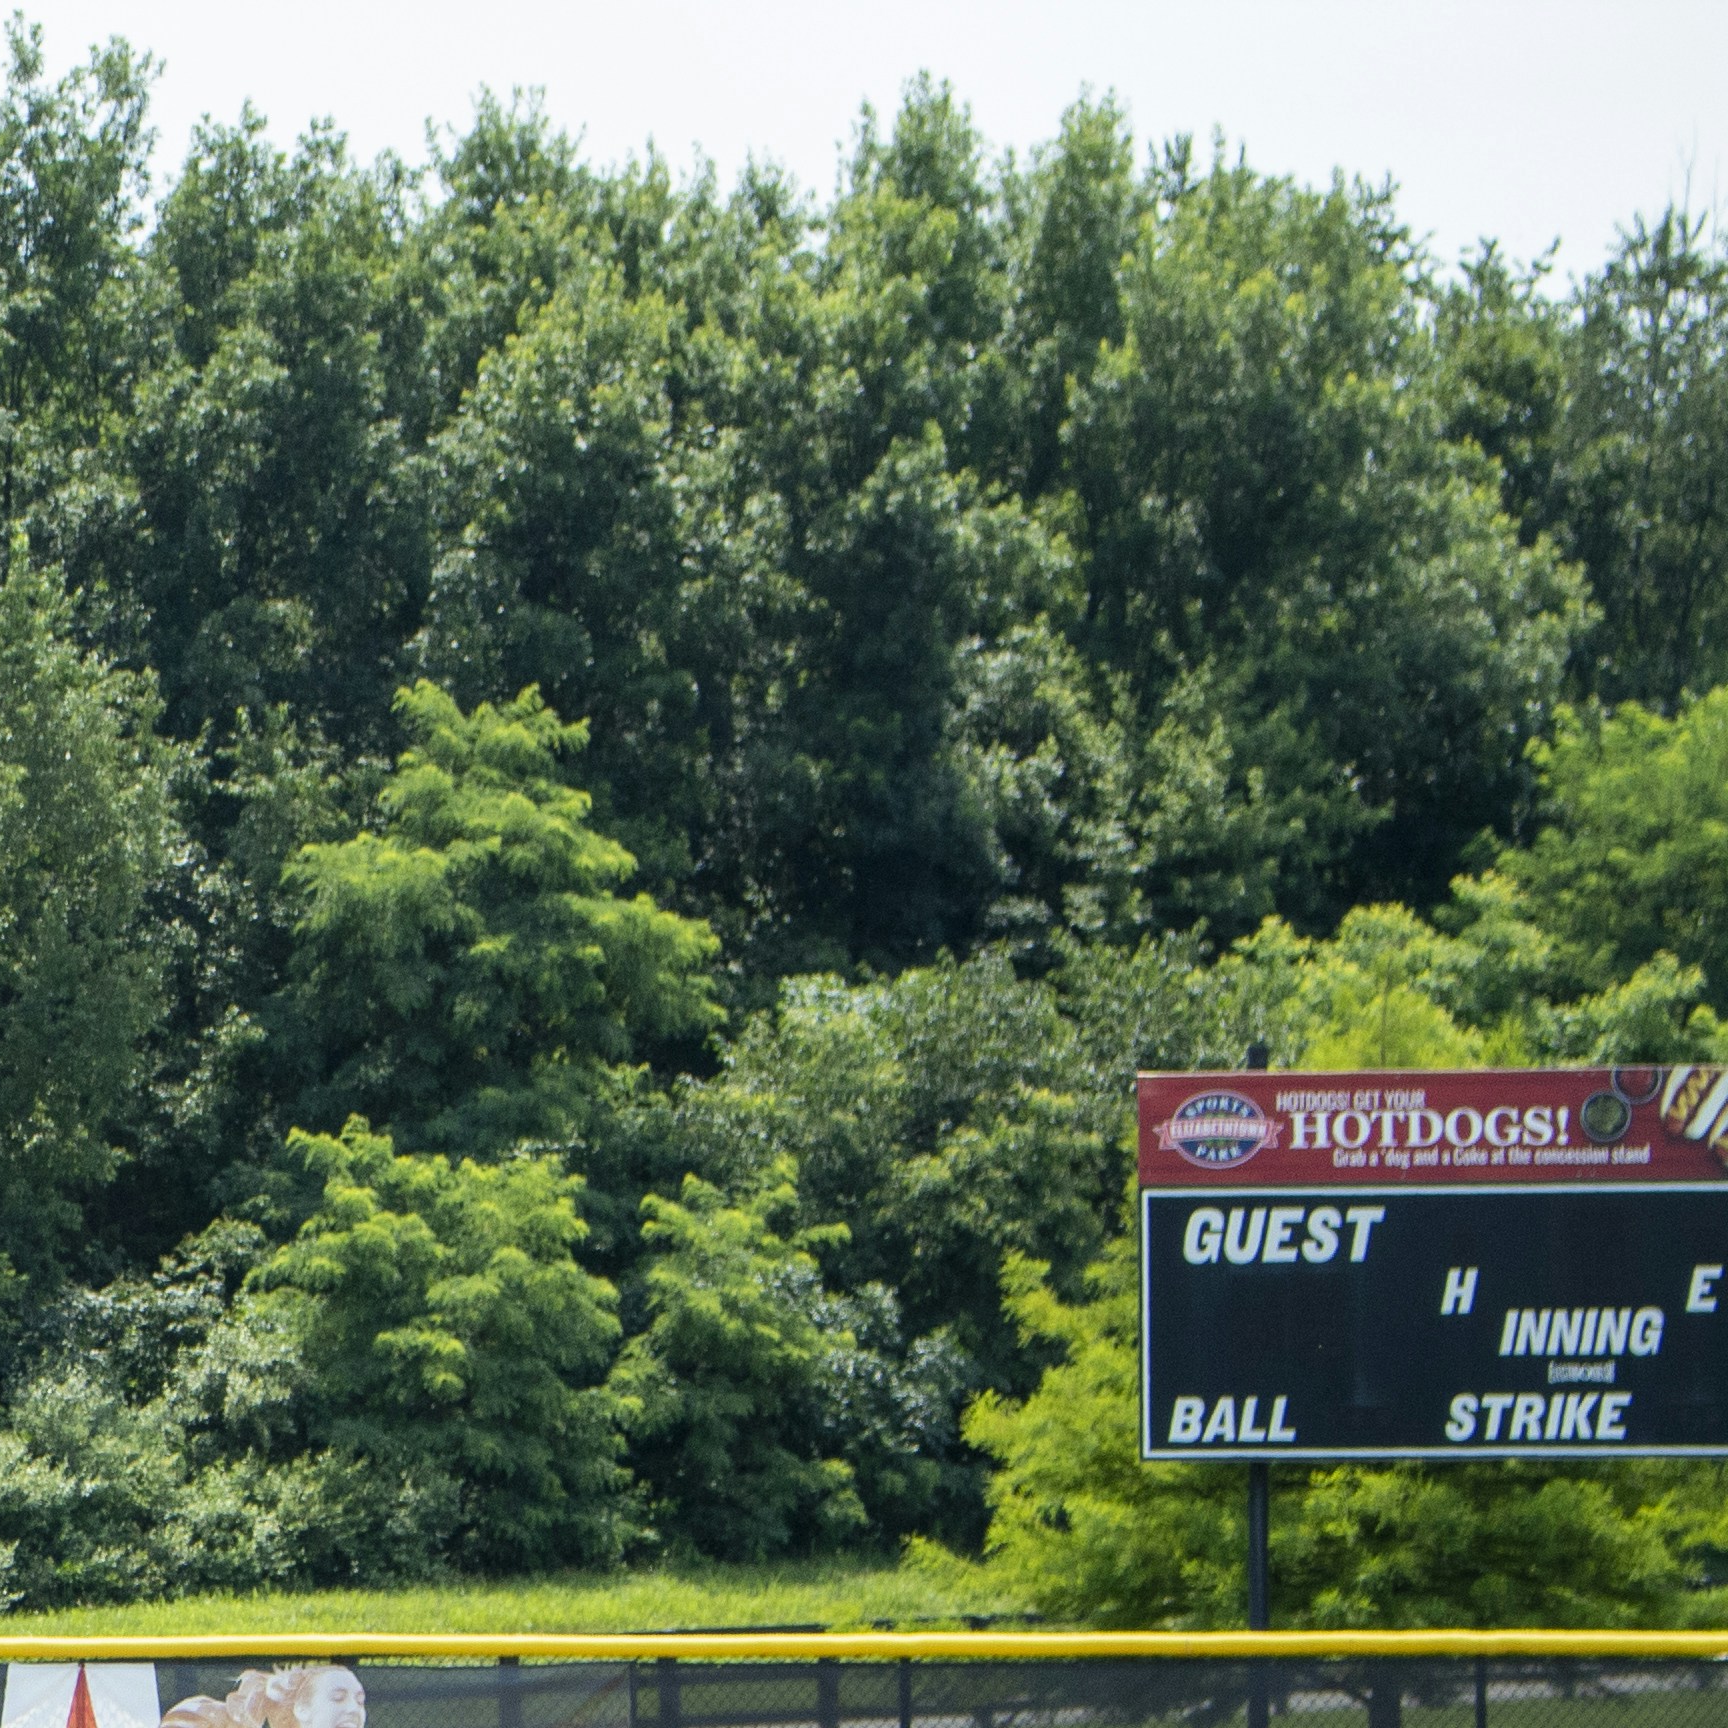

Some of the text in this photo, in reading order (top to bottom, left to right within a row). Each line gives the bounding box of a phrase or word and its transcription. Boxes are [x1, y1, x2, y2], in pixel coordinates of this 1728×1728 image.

[1184, 1096, 1252, 1118] SPORTS
[1354, 1090, 1381, 1111] GET
[1384, 1089, 1426, 1110] YOUR
[1289, 1105, 1571, 1149] HOTDOGS!
[1195, 1143, 1244, 1161] PARK
[1333, 1147, 1367, 1168] Grab
[1369, 1151, 1379, 1167] a
[1413, 1145, 1439, 1166] and
[1441, 1151, 1451, 1166] a
[1453, 1146, 1489, 1166] Coke
[1491, 1148, 1505, 1165] at
[1508, 1146, 1532, 1165] the
[1534, 1144, 1610, 1165] concession
[1611, 1142, 1651, 1164] stand
[1183, 1206, 1385, 1264] GUEST
[1441, 1267, 1479, 1315] H
[1686, 1264, 1724, 1312] E
[1499, 1307, 1665, 1356] INNING
[1168, 1396, 1297, 1443] BALL
[1445, 1391, 1633, 1440] STRIKE
